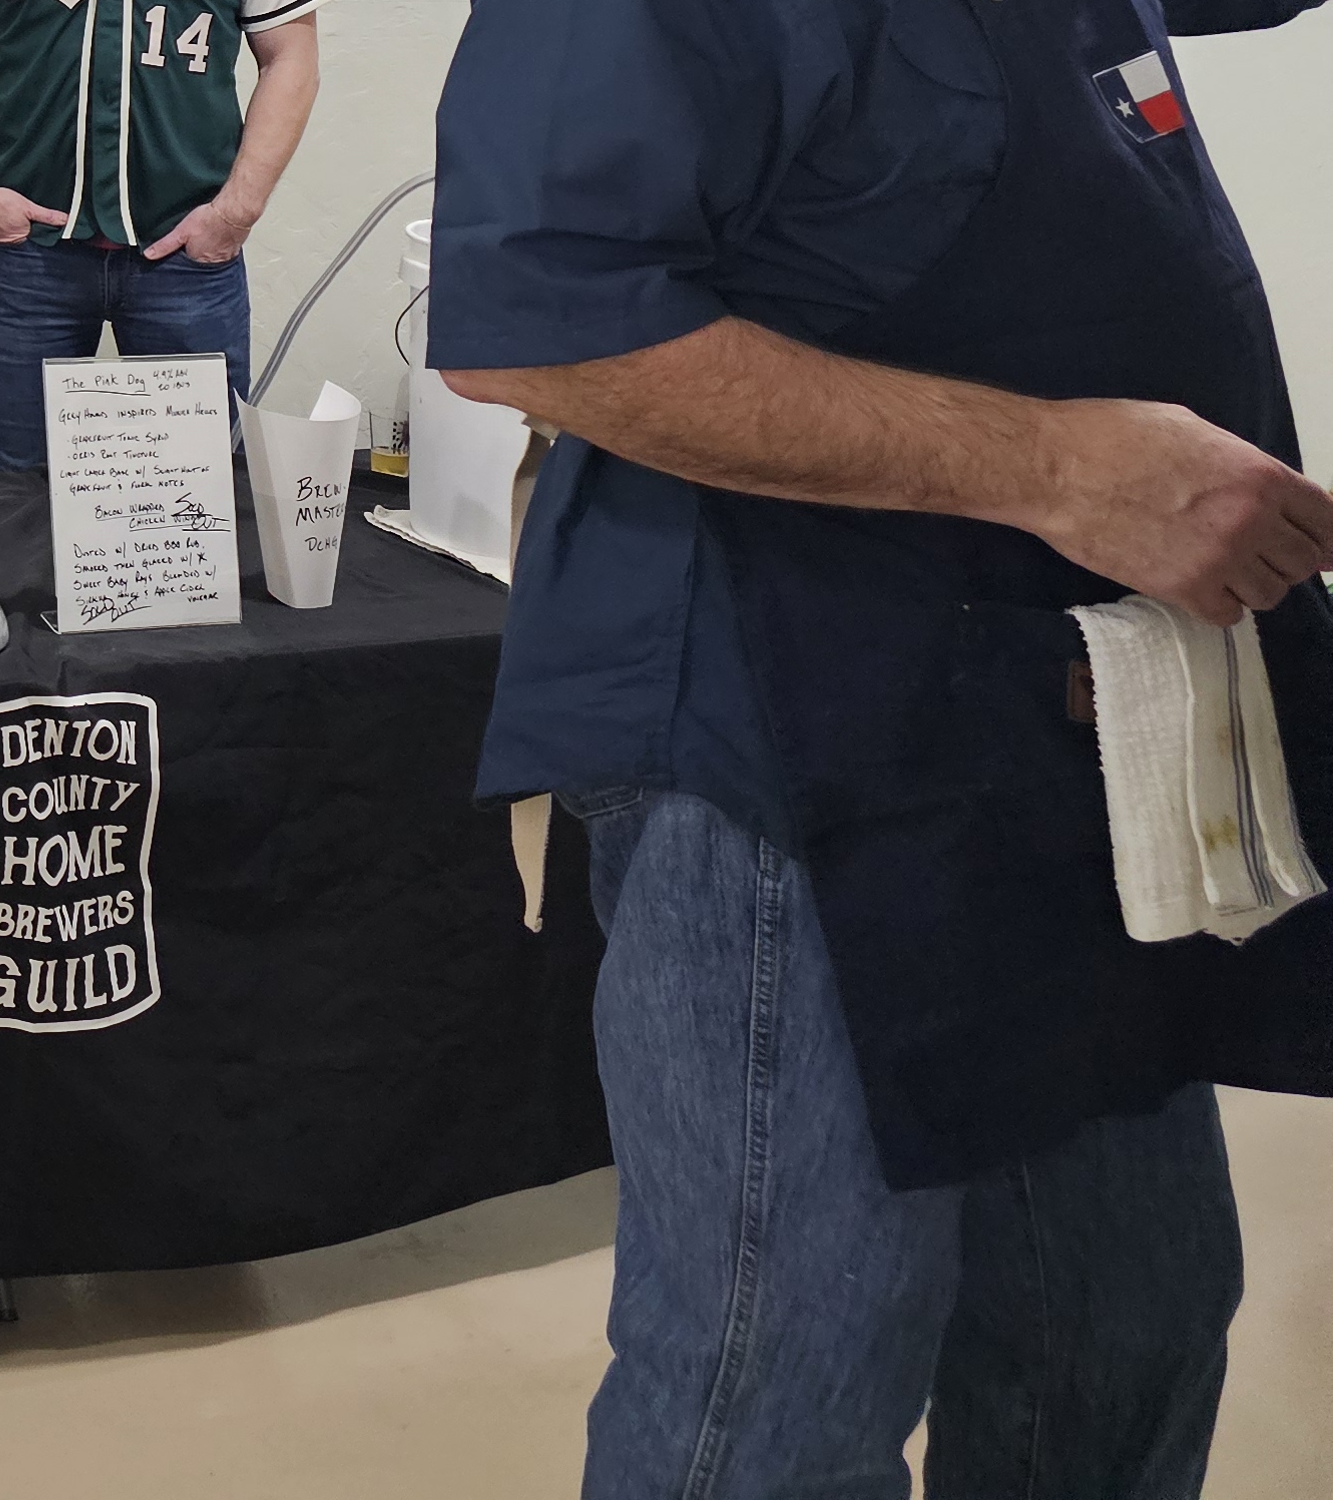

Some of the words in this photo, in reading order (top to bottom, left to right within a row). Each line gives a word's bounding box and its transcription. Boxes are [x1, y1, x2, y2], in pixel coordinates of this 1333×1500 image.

[141, 5, 211, 74] 14
[62, 378, 86, 388] The
[94, 374, 119, 386] Pink
[127, 374, 146, 392] Dog
[0, 719, 137, 767] DENTON
[1, 775, 140, 822] COUNTY
[0, 825, 127, 886] HOME
